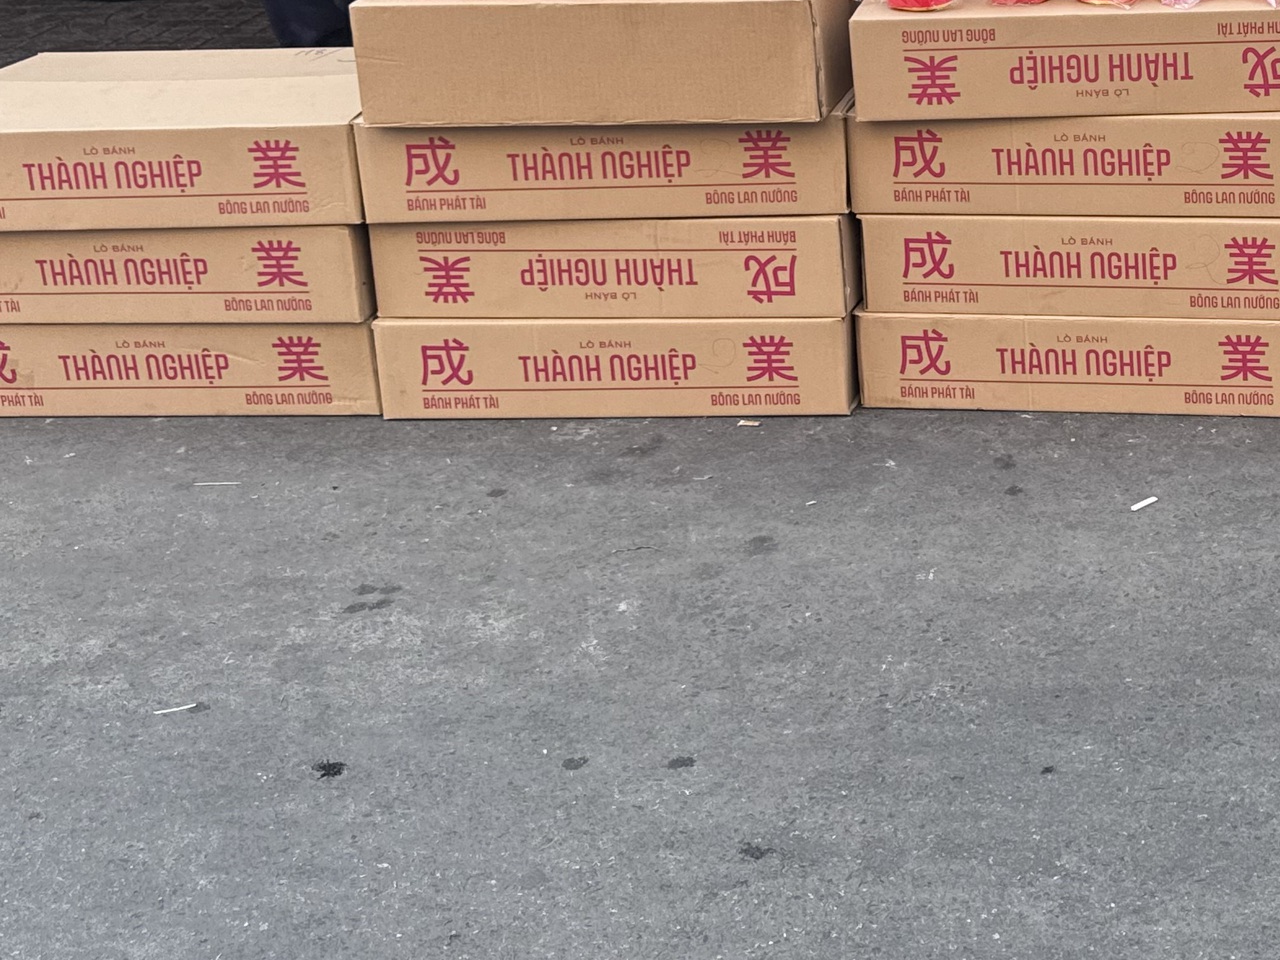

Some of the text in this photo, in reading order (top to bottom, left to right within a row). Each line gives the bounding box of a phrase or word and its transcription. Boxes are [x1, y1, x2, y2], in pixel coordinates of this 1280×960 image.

[248, 139, 306, 189] 業
[405, 136, 459, 186] 成
[738, 130, 796, 180] 業
[892, 129, 946, 179] 成
[1219, 131, 1274, 180] 業
[251, 240, 308, 287] 業
[744, 254, 797, 304] 成
[902, 231, 955, 280] 成
[1224, 236, 1279, 285] 業
[934, 289, 961, 303] PHÁT
[963, 289, 979, 304] TÀI
[271, 336, 328, 382] 業
[422, 338, 473, 386] 成
[742, 335, 799, 383] 業
[900, 328, 951, 376] 成
[1218, 334, 1273, 382] 業
